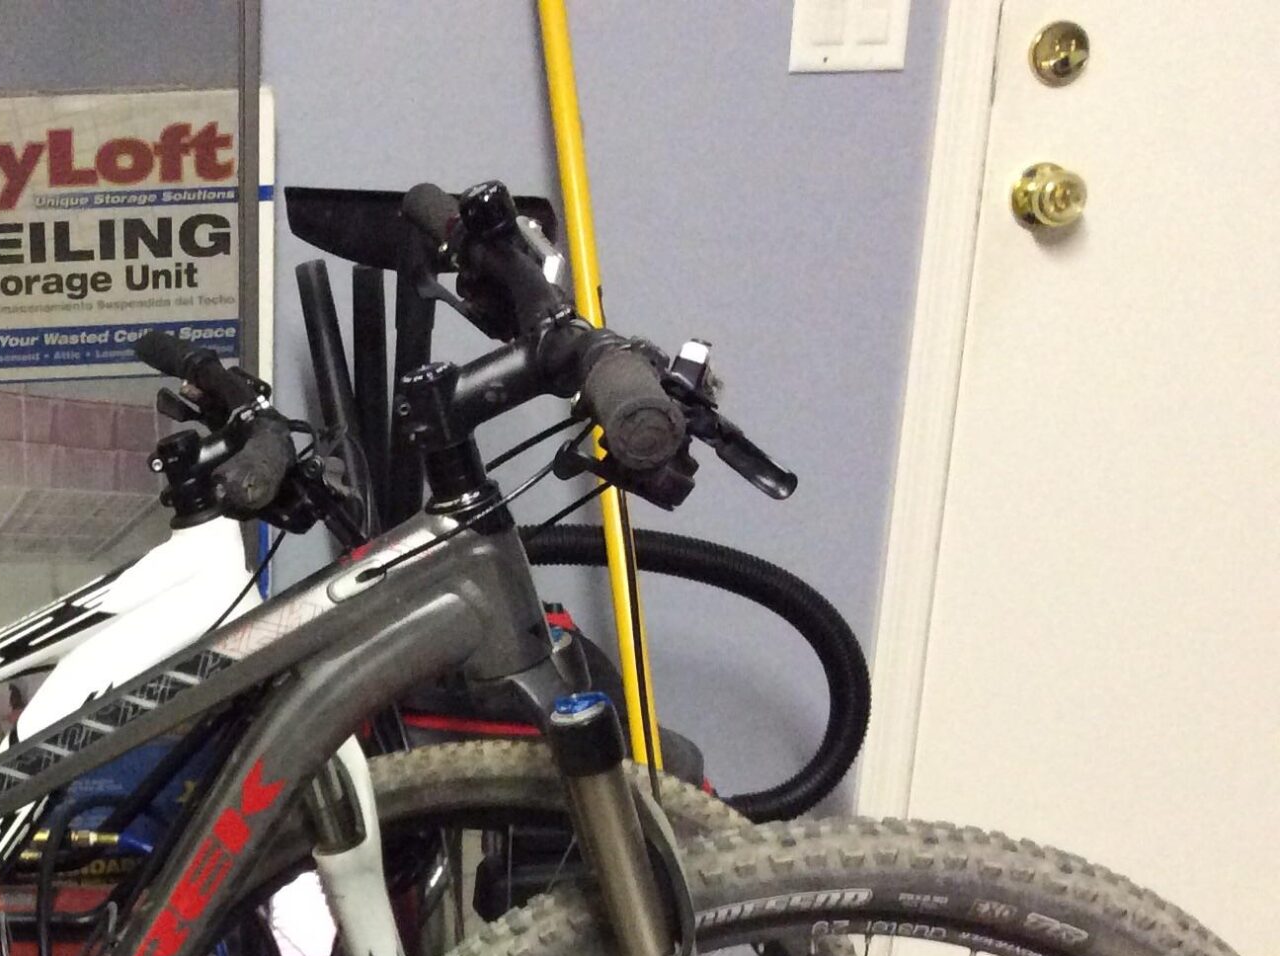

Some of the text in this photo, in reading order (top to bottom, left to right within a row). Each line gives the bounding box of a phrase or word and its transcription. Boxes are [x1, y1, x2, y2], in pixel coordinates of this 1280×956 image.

[35, 188, 235, 209] Unique Storage Solutions
[125, 262, 198, 292] Unit
[0, 334, 39, 348] Your
[43, 328, 109, 346] Wasted
[179, 325, 236, 342] Space
